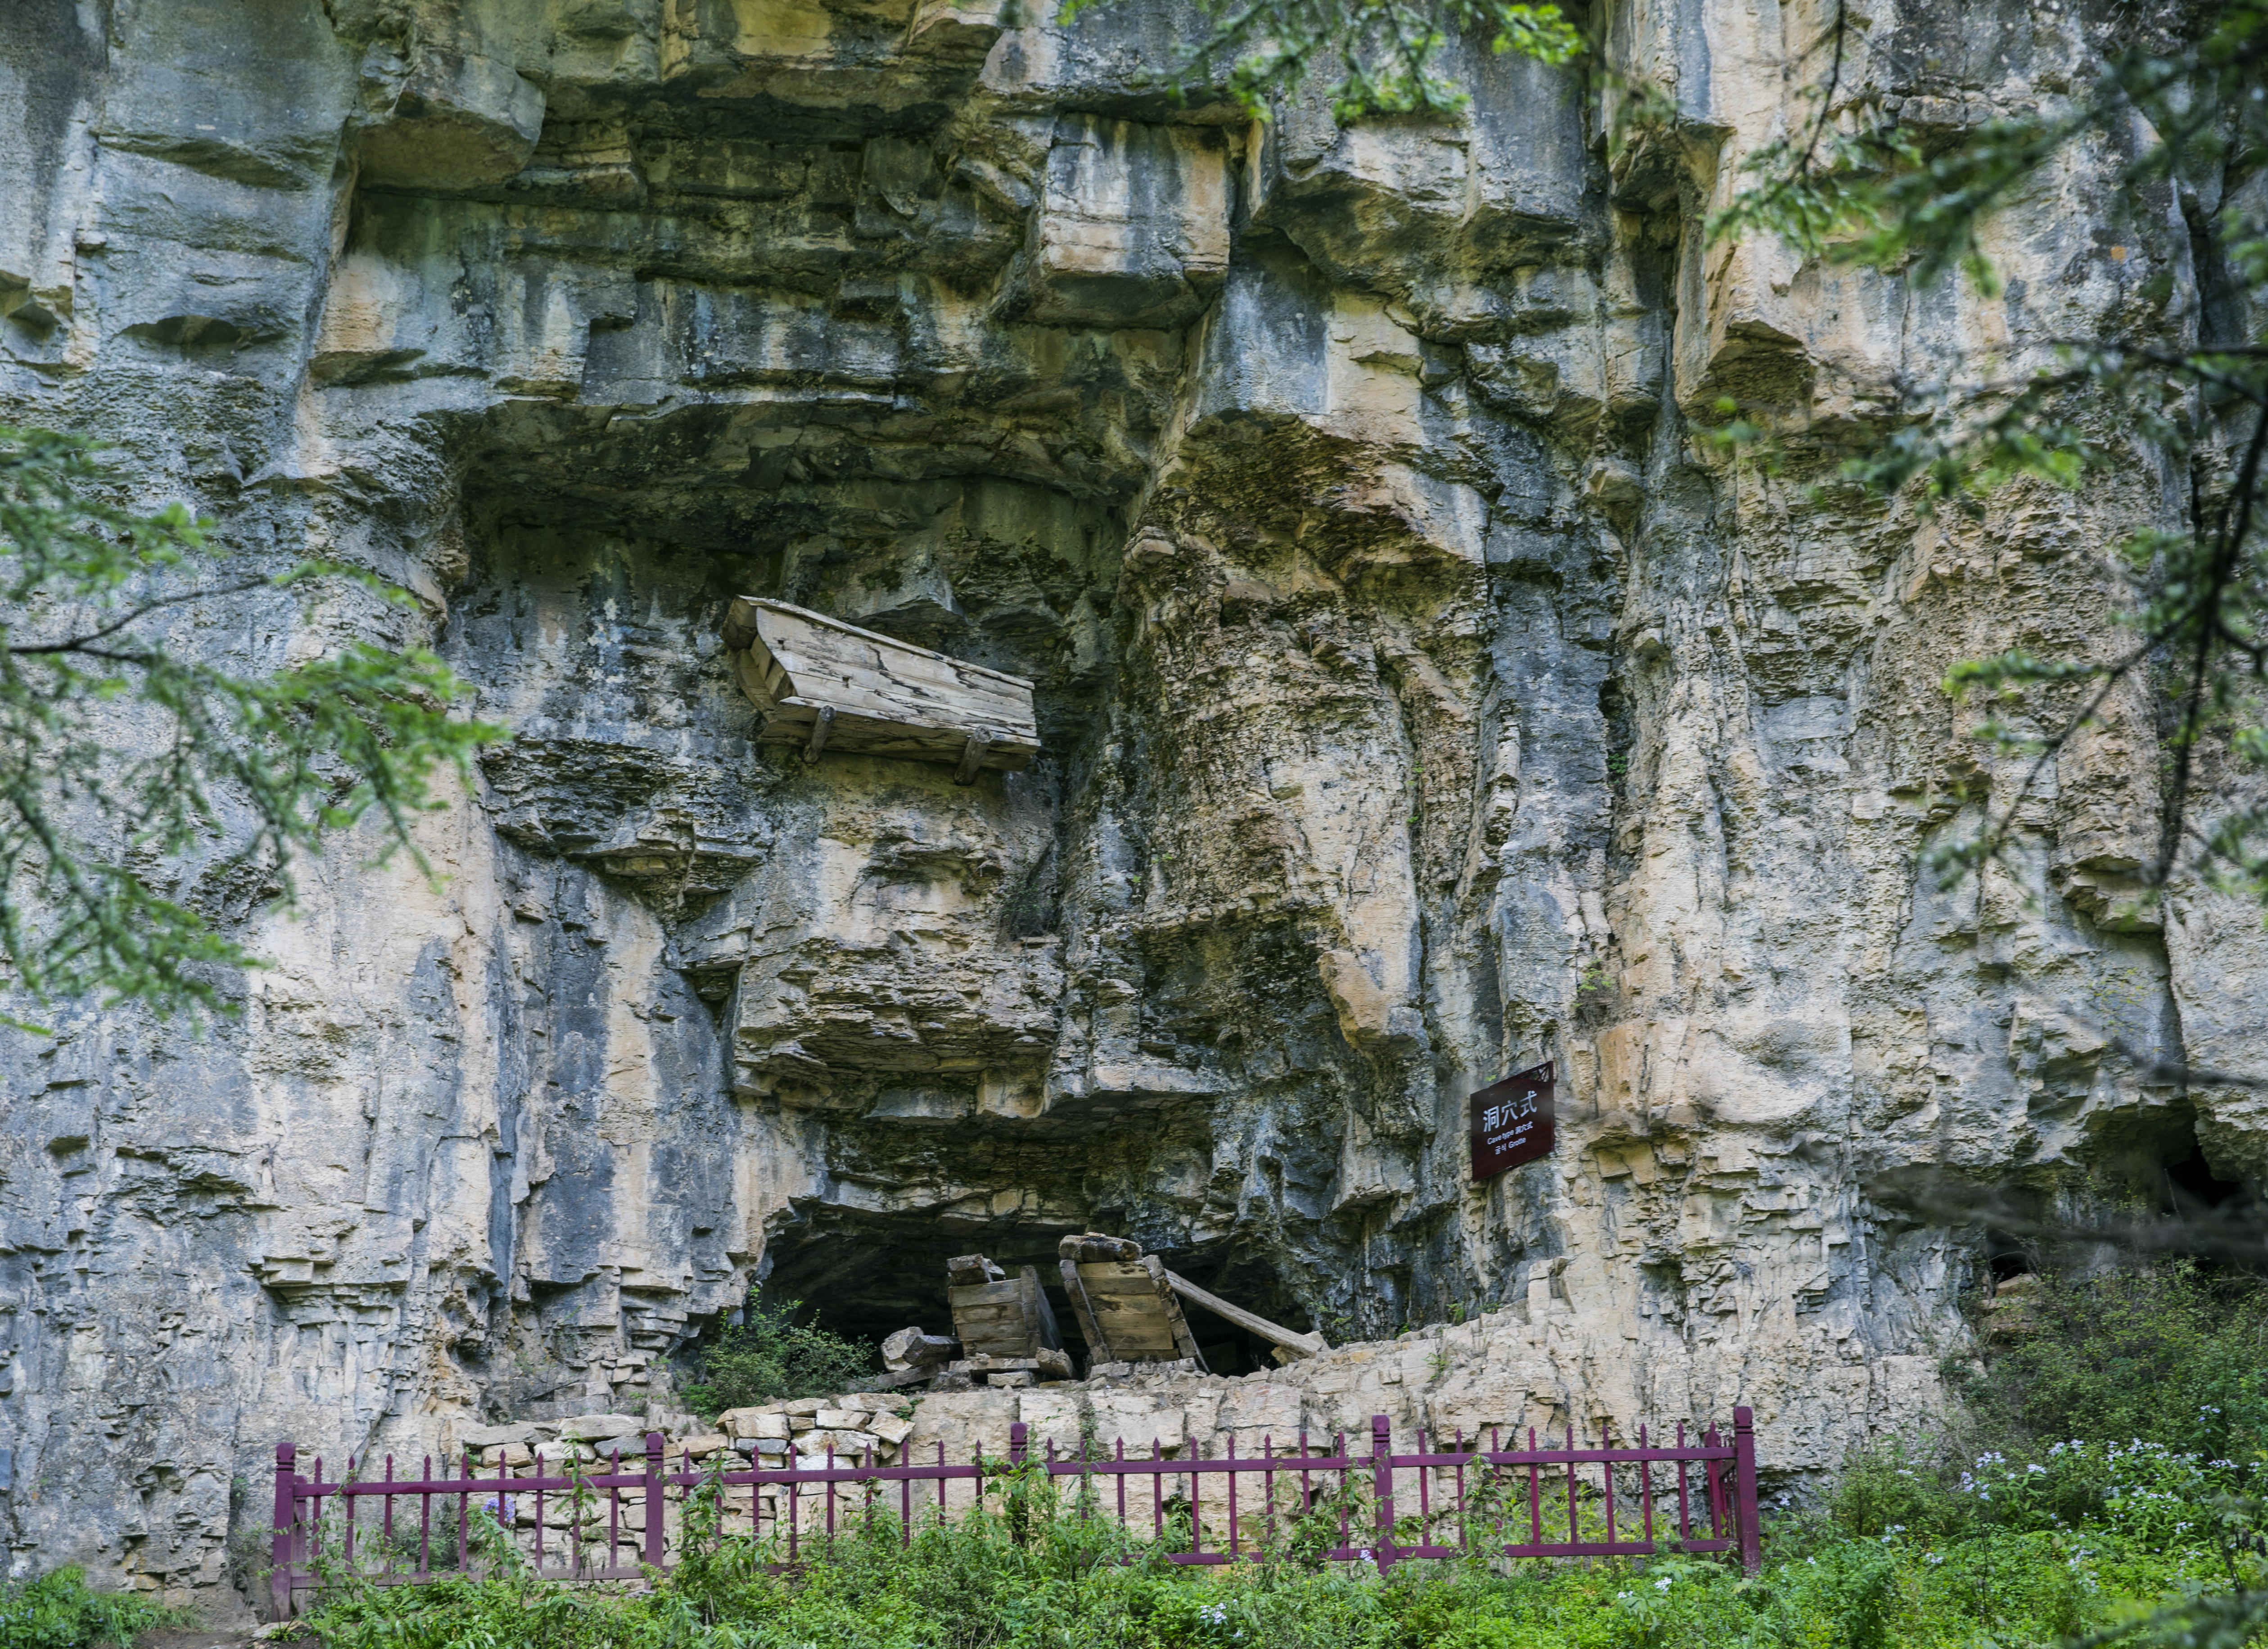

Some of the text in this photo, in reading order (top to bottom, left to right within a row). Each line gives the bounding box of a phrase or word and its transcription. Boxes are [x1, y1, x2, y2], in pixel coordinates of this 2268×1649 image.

[1483, 1090, 1537, 1132] 洞穴式
[1487, 1135, 1502, 1145] Cave
[1502, 1129, 1514, 1139] type
